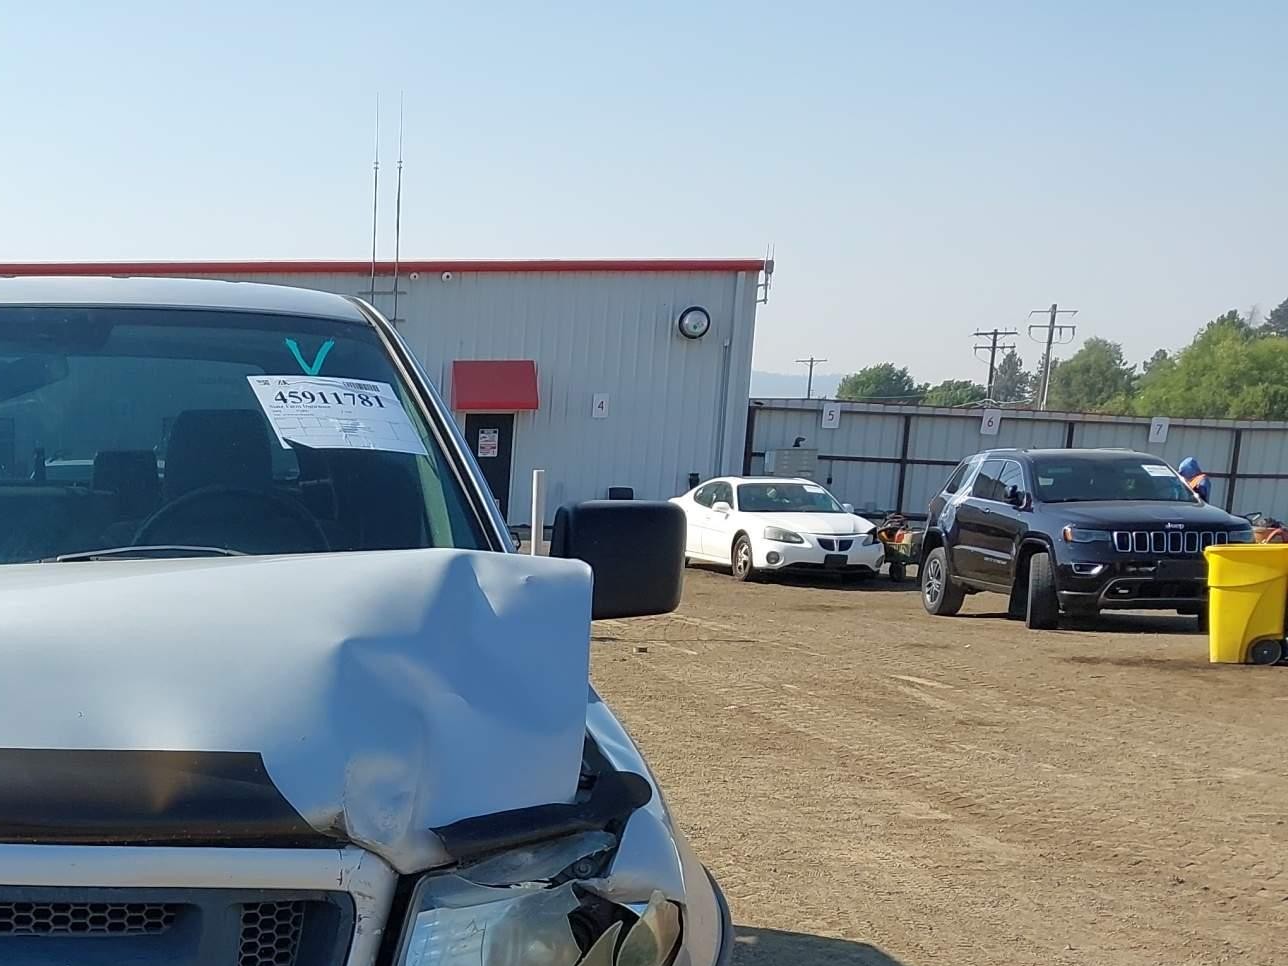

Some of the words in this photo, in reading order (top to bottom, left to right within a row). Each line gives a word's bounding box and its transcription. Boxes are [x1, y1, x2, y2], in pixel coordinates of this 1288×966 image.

[274, 390, 387, 409] 45911781
[597, 400, 604, 411] 4
[828, 410, 834, 421] 5
[987, 415, 994, 427] 6
[1156, 424, 1163, 435] 7
